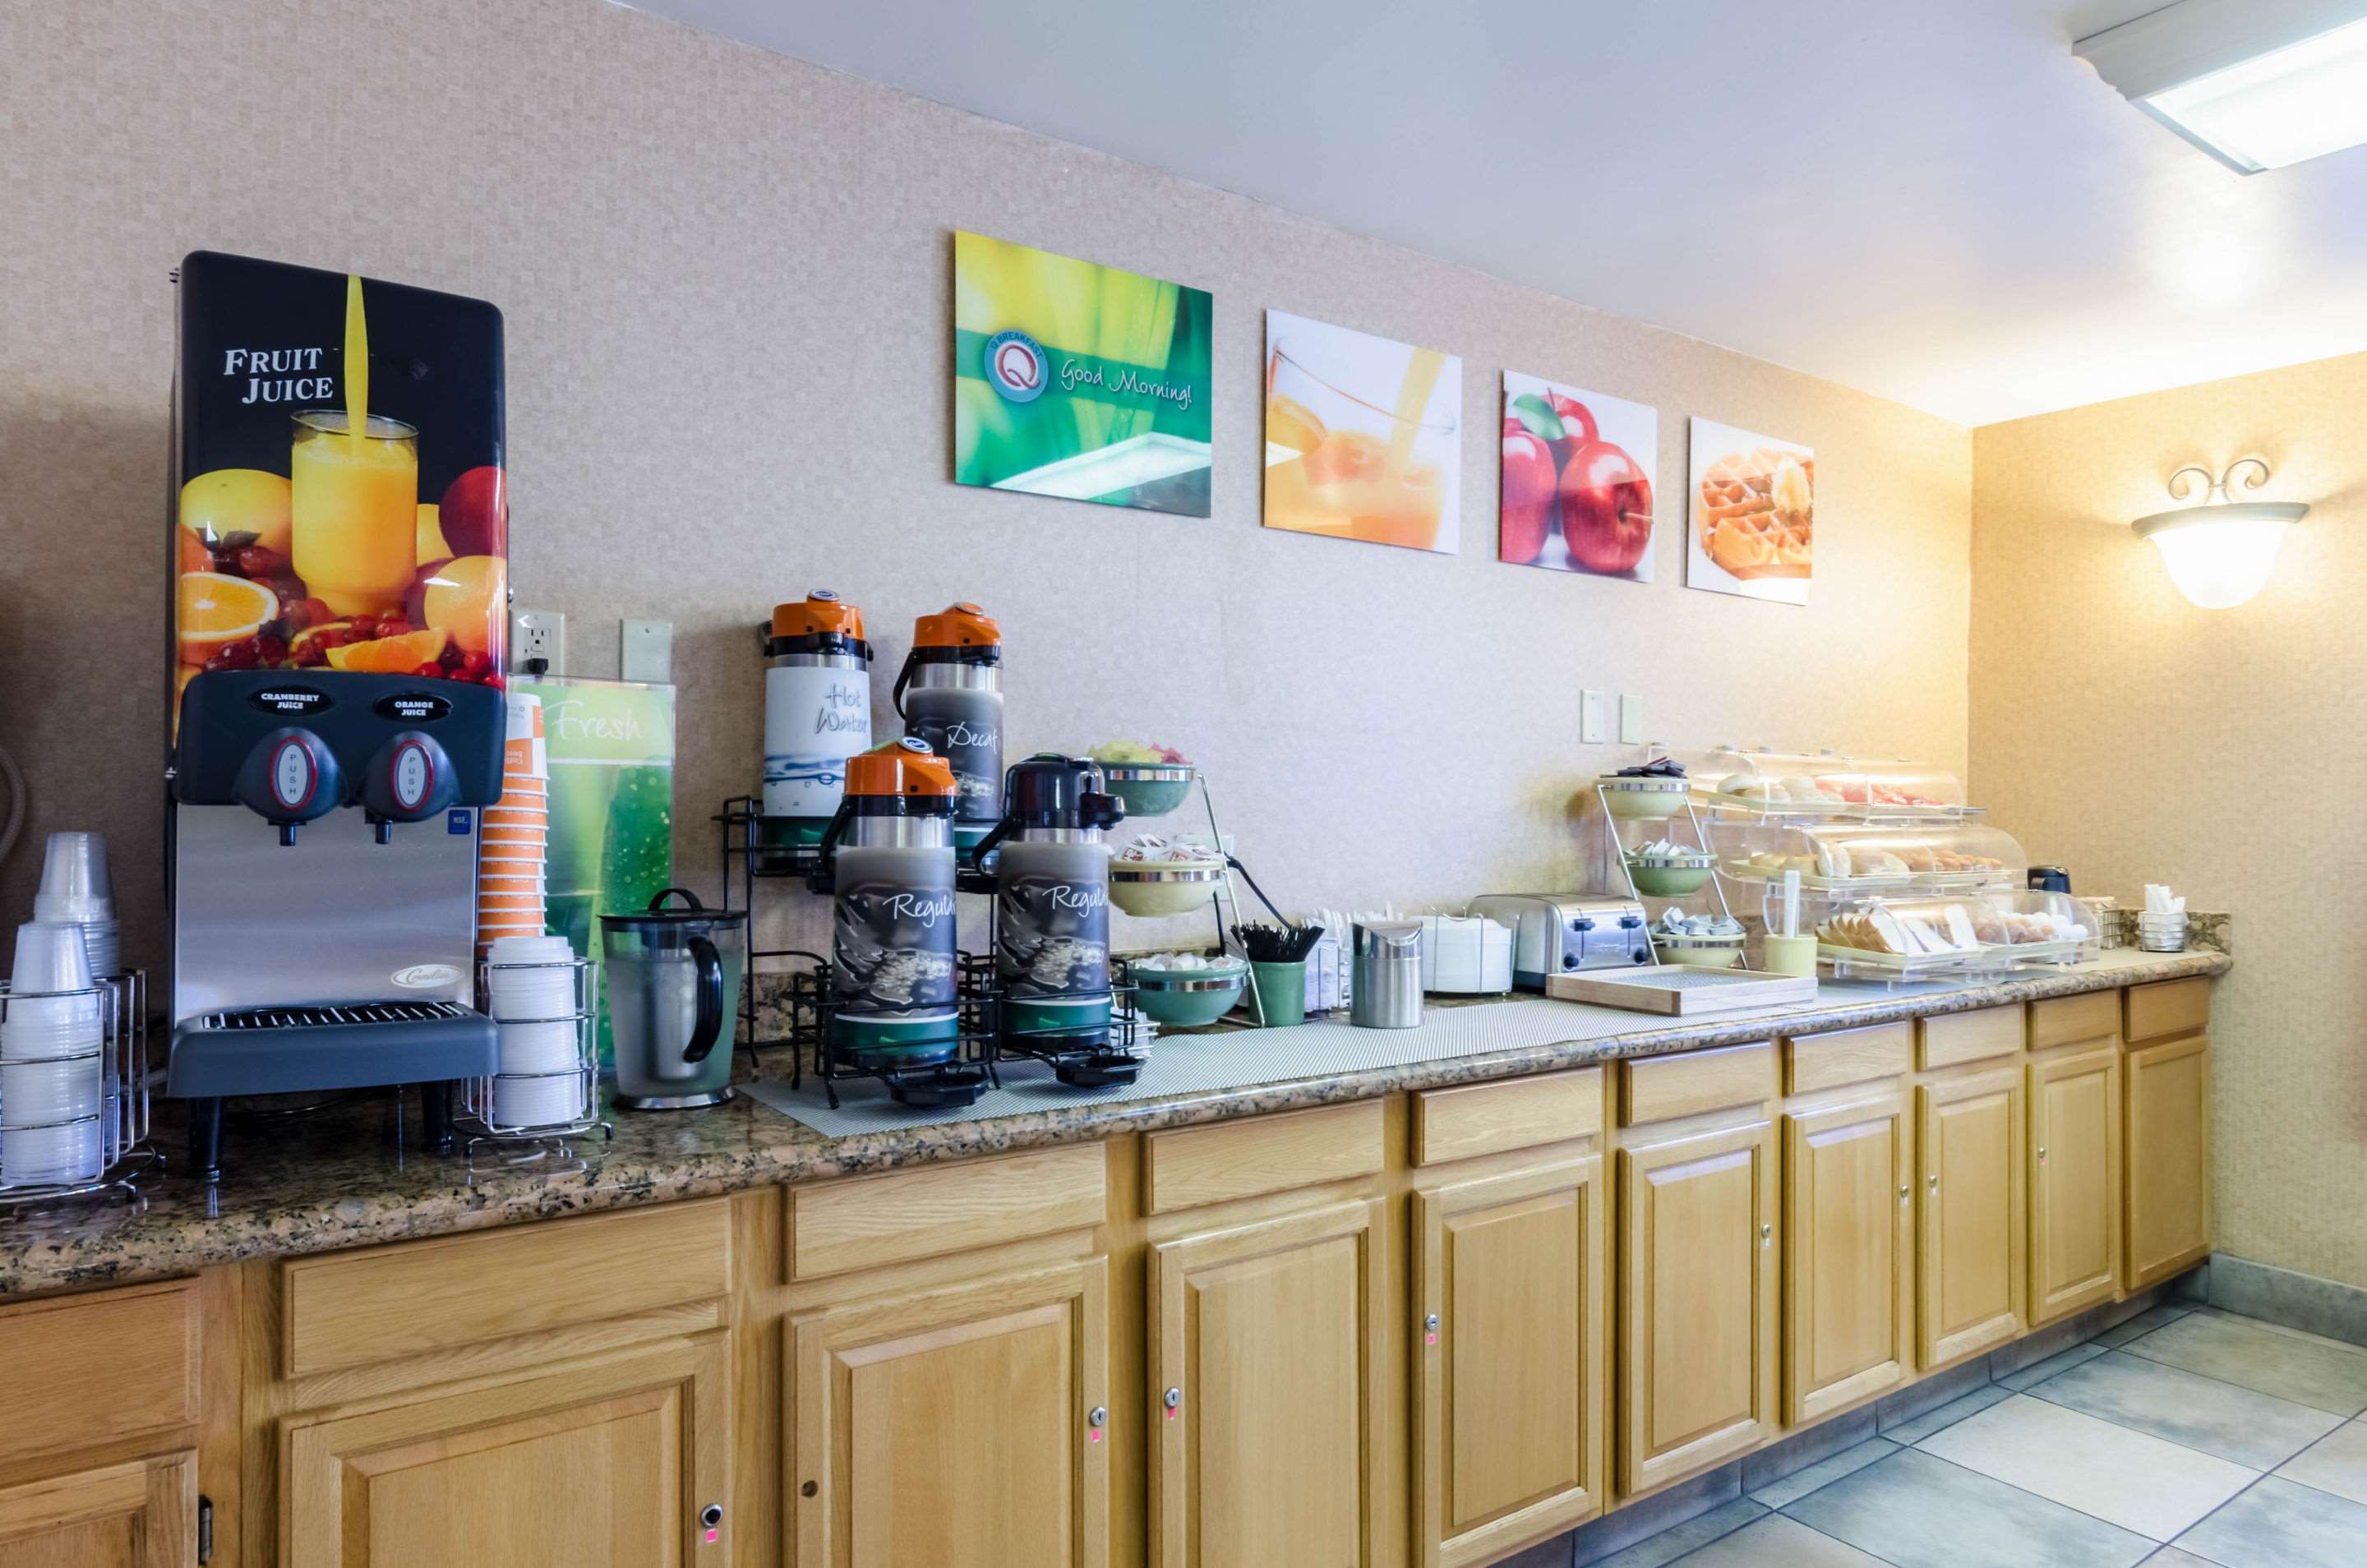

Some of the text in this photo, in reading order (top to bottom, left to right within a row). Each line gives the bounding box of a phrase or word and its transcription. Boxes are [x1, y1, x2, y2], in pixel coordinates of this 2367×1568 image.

[997, 331, 1043, 357] BREAKFAST
[224, 348, 322, 376] FRUIT
[242, 377, 333, 404] JUICE
[1061, 358, 1192, 411] Good Morning!
[261, 693, 319, 702] CRANBERRY
[277, 701, 303, 710] JUICE
[824, 682, 861, 708] Hot
[401, 708, 426, 717] JUICE
[545, 699, 644, 741] Fresh
[814, 707, 867, 735] Water
[946, 721, 998, 754] Decaf
[1042, 885, 1109, 918] Regula
